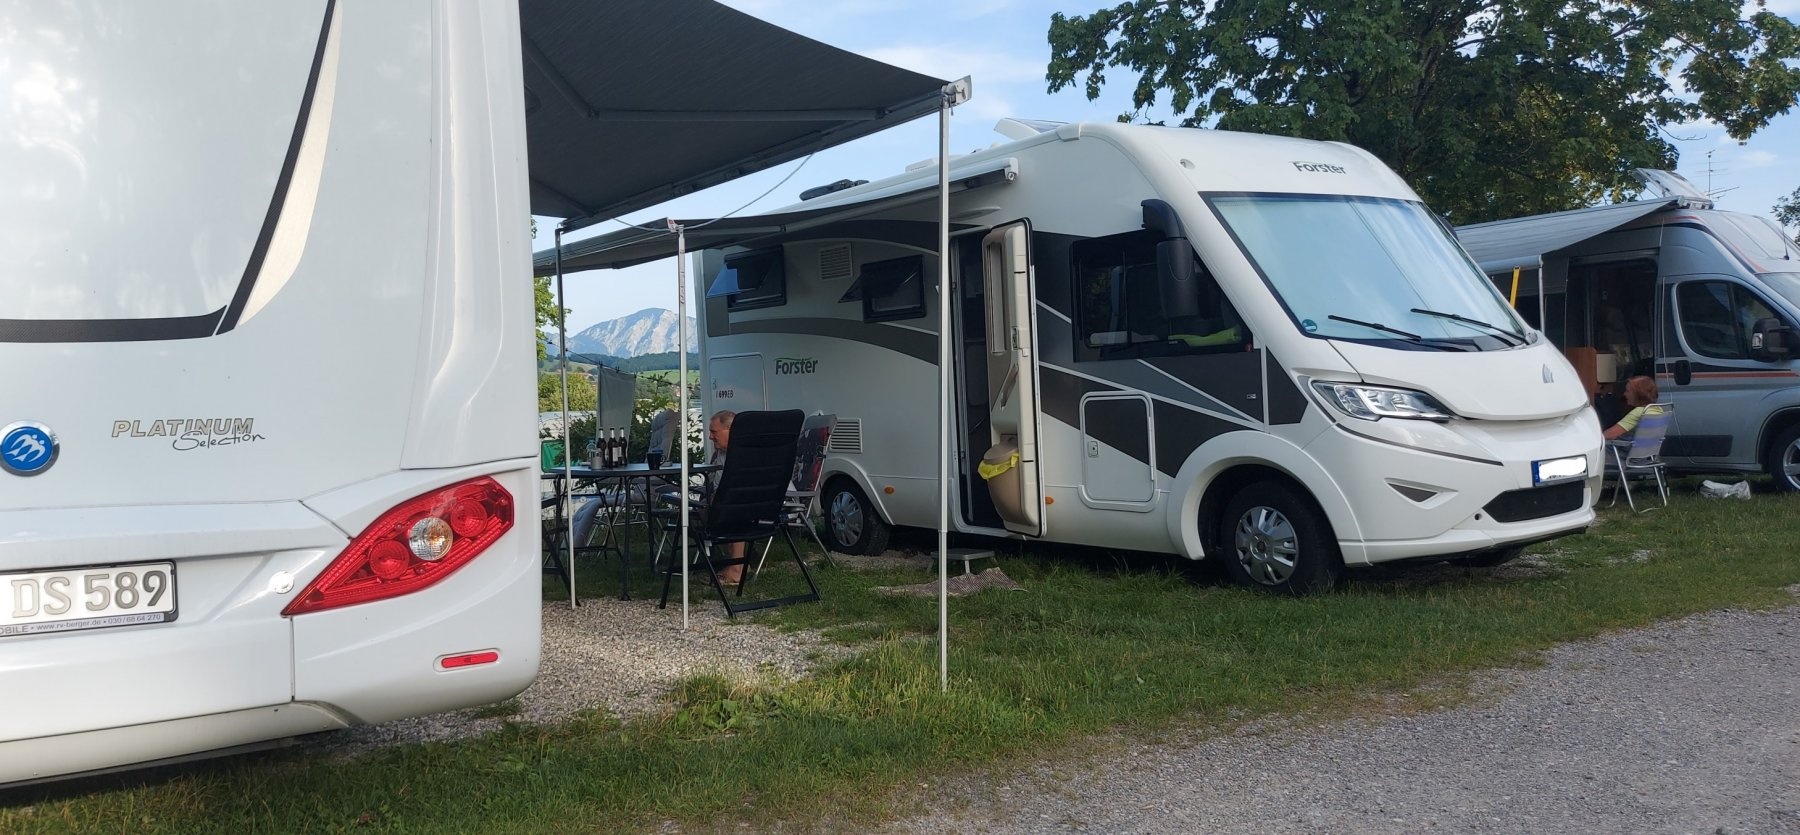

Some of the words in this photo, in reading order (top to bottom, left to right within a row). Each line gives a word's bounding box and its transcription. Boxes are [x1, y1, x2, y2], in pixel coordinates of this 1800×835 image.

[1290, 161, 1346, 174] Forster
[775, 358, 818, 375] Forster
[111, 417, 254, 438] PLATINUM
[172, 423, 266, 451] Selection
[10, 576, 72, 619] DS
[83, 570, 167, 612] 589
